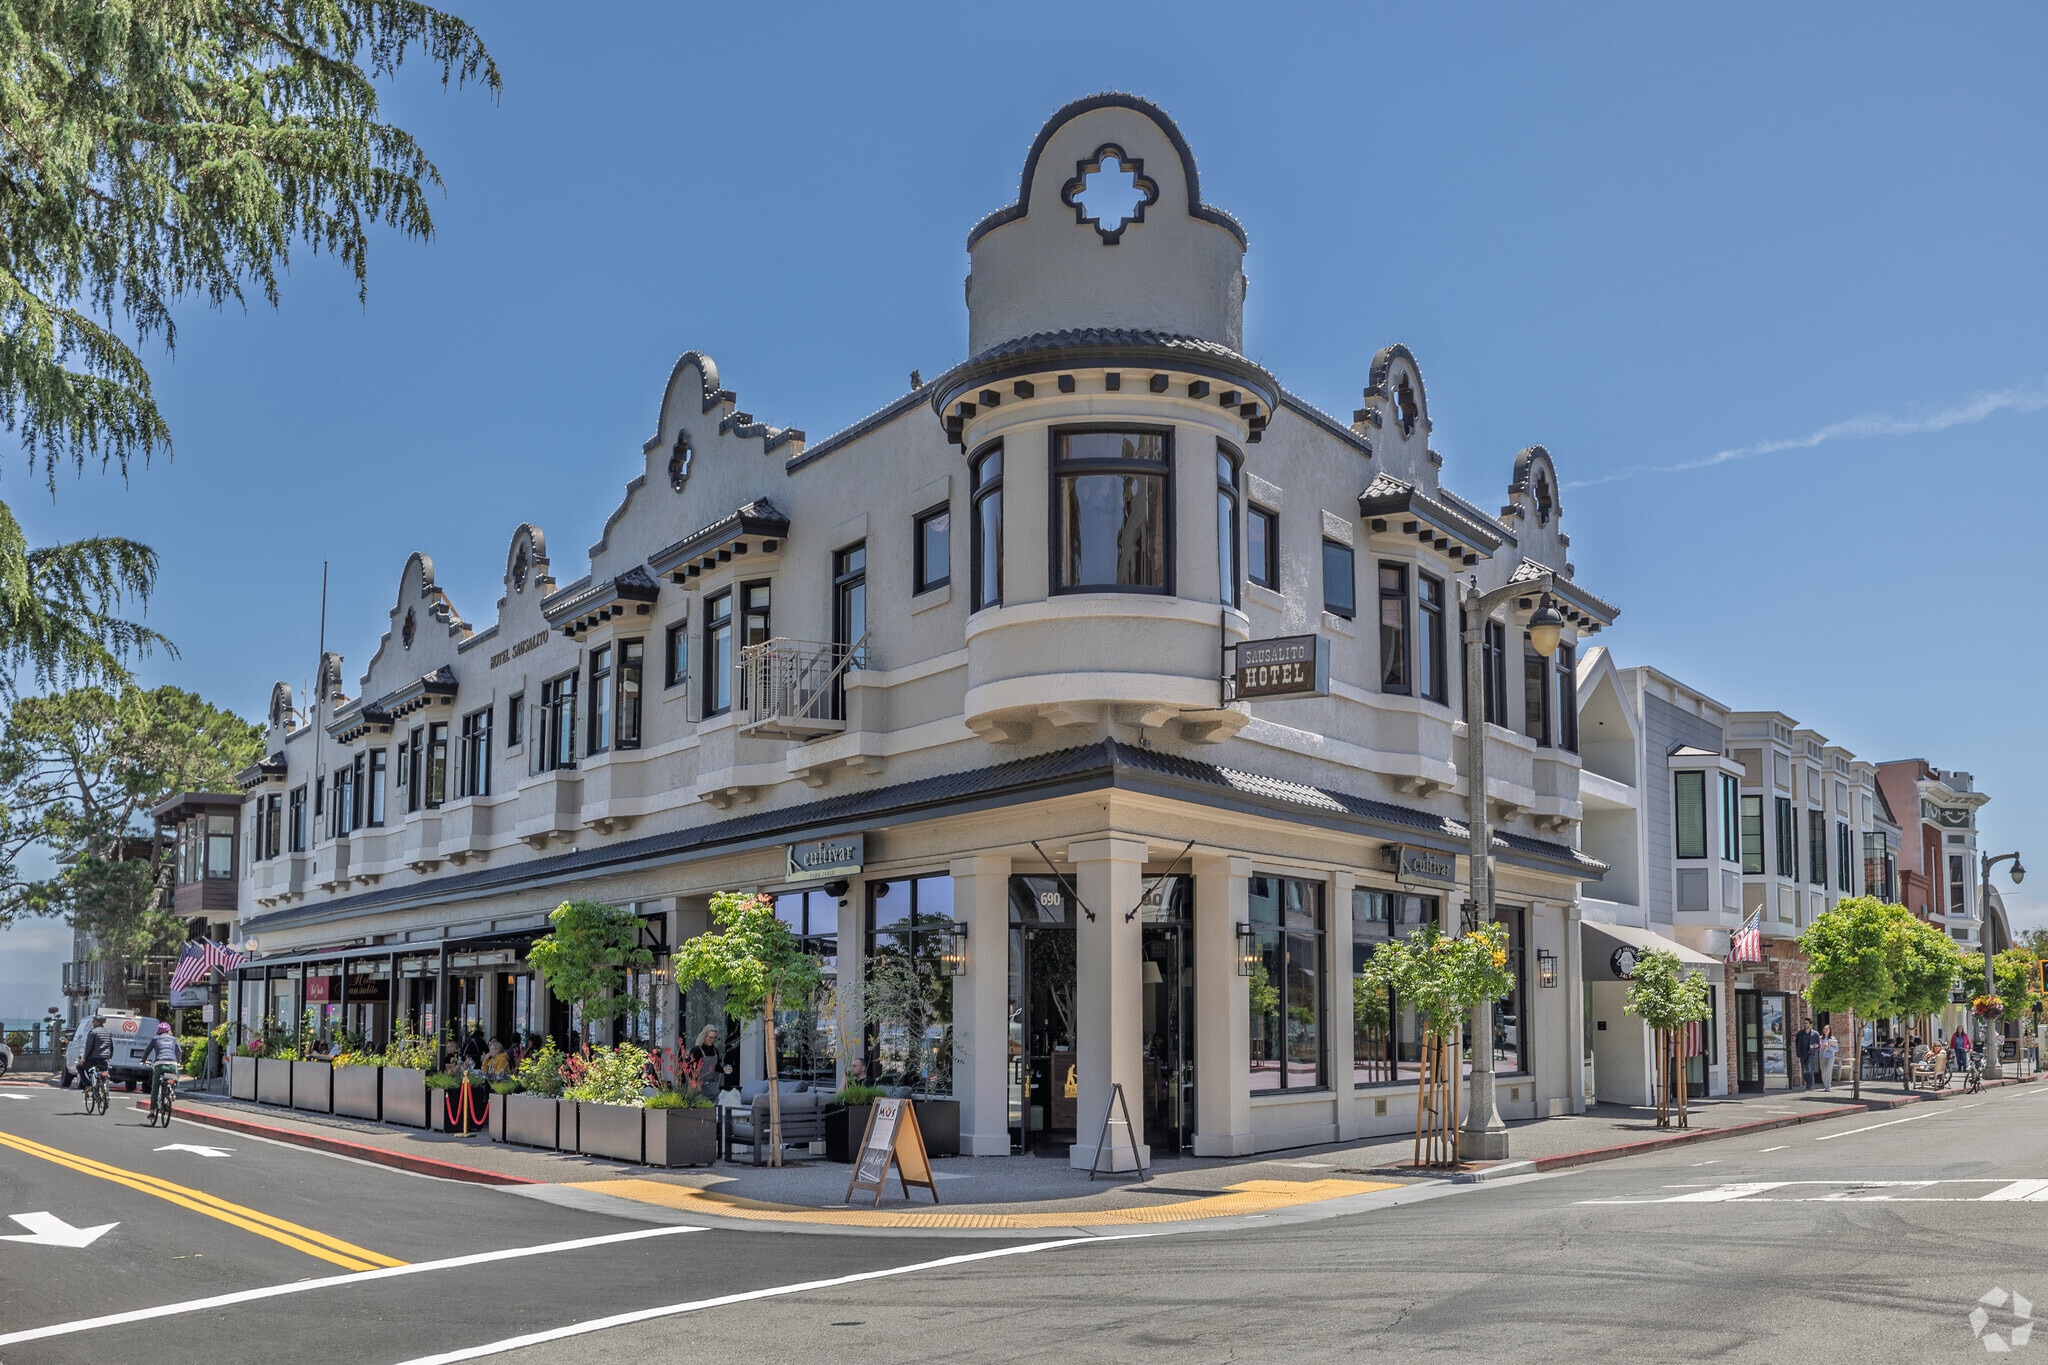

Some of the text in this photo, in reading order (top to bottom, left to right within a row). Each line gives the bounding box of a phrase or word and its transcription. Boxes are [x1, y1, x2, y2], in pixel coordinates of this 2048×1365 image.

[491, 629, 549, 669] HOTEL SAUSALITO
[1246, 646, 1305, 664] SAUSALITO
[1246, 663, 1304, 688] HOTEL
[803, 842, 854, 867] cultivar
[1414, 852, 1451, 876] cultivar
[1040, 892, 1061, 906] 690
[1141, 893, 1163, 907] 90
